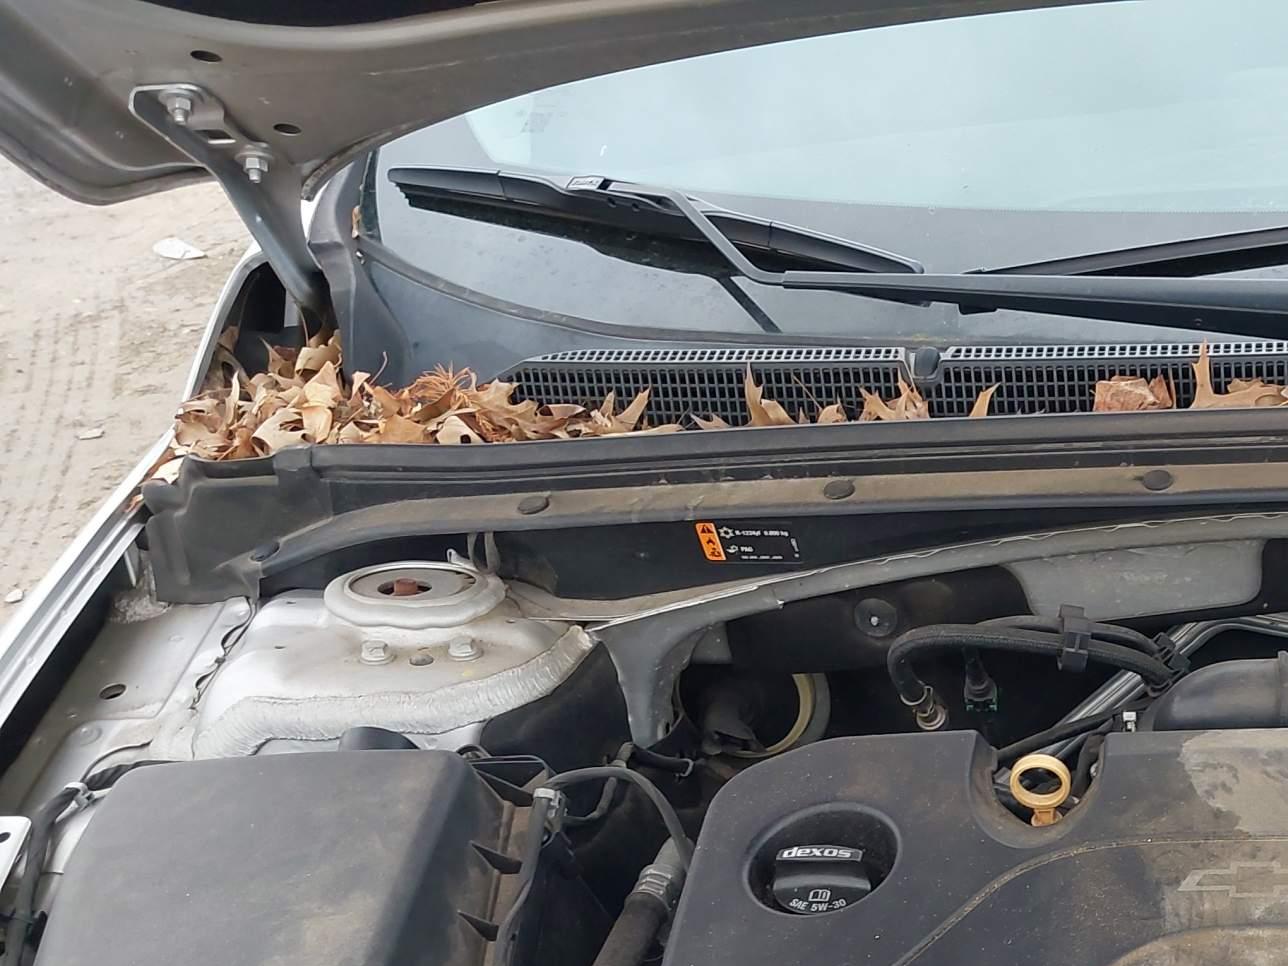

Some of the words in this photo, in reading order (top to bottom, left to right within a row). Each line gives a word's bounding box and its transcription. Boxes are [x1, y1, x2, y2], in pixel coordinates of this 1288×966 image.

[781, 846, 852, 859] dexos
[789, 898, 808, 911] SAE
[810, 899, 847, 912] 5W-30
